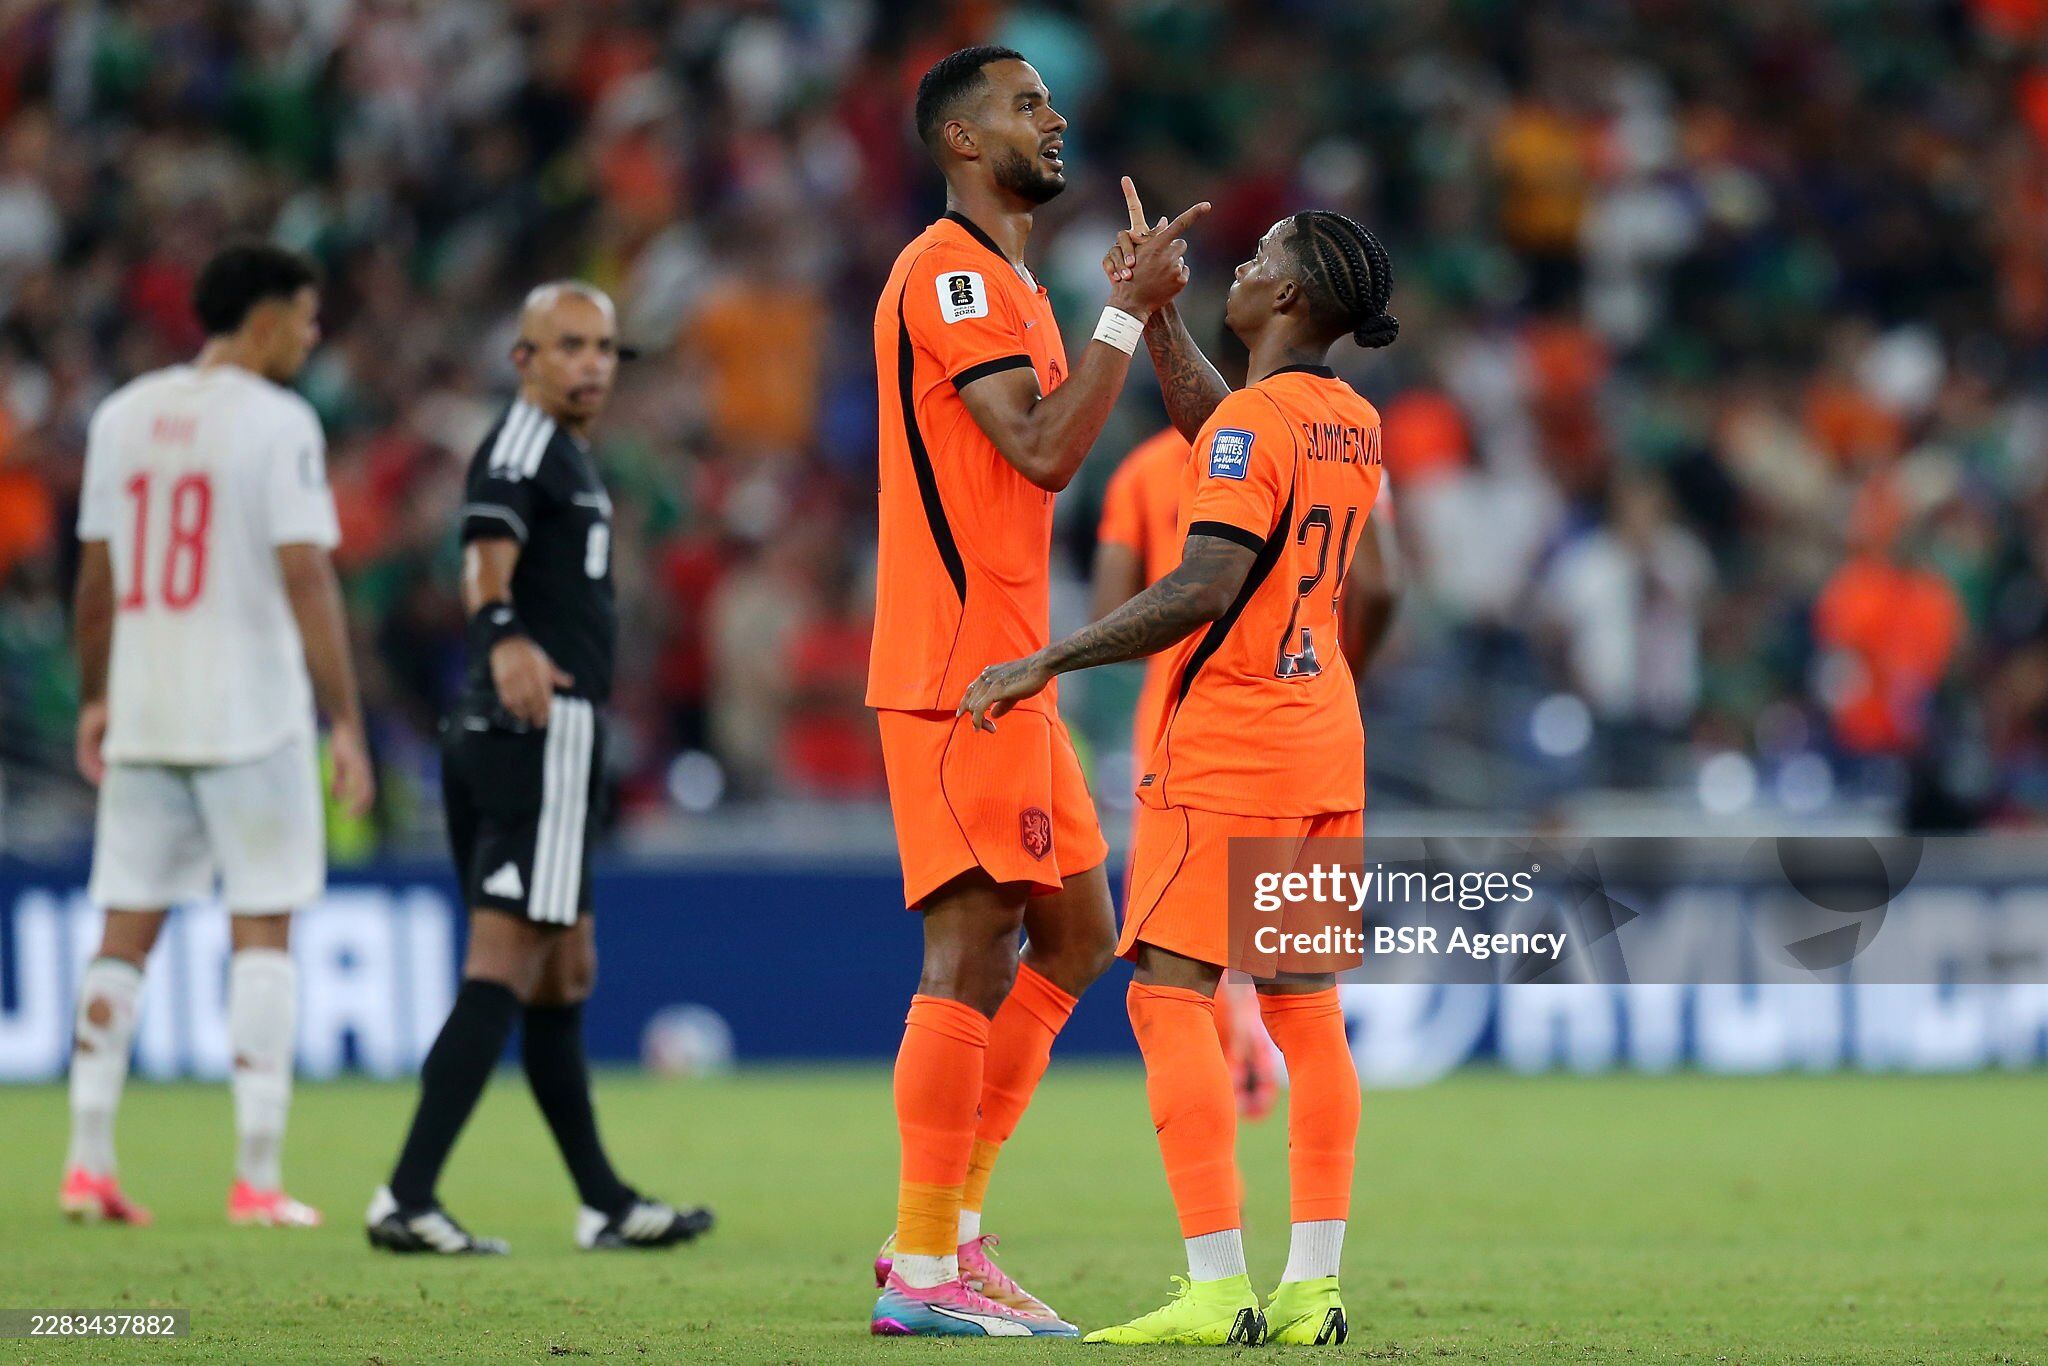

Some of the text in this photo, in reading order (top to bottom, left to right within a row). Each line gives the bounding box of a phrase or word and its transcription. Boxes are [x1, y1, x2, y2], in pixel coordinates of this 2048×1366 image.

[954, 309, 976, 317] 2026
[1218, 435, 1245, 445] FOOTBALL
[1215, 443, 1244, 456] UNITES
[120, 473, 212, 612] 18
